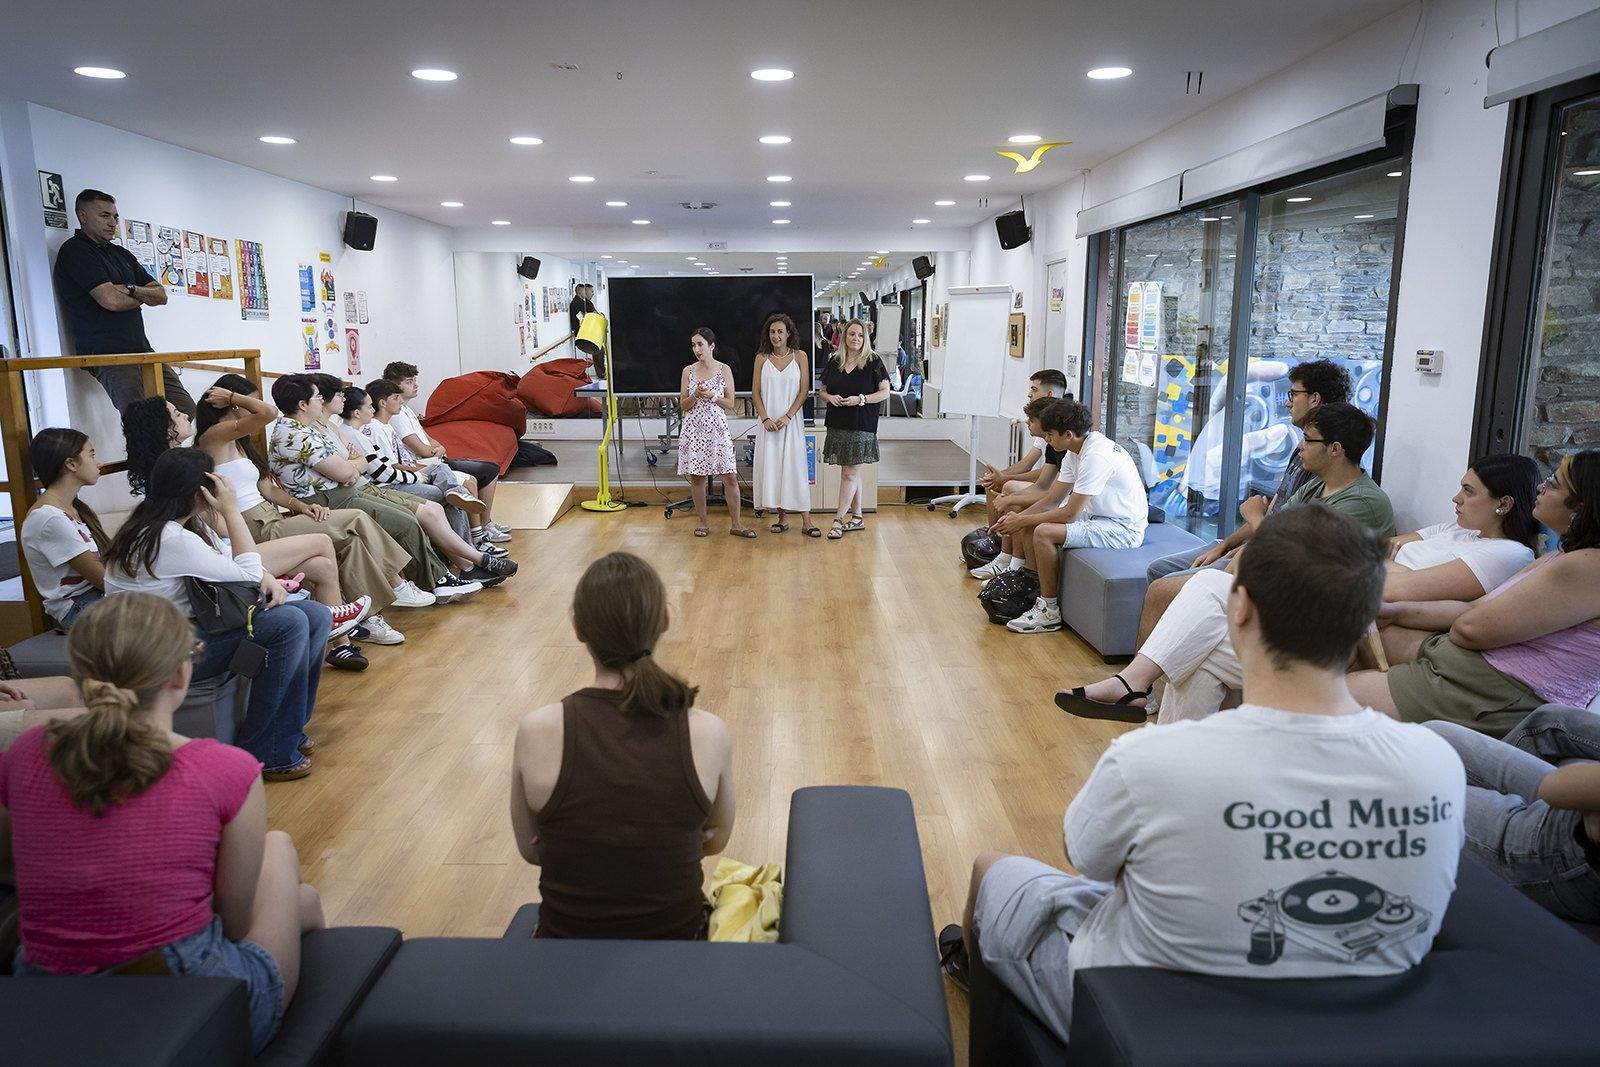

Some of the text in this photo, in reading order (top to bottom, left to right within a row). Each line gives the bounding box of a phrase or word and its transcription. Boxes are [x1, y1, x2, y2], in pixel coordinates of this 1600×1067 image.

[1223, 795, 1452, 830] Good Music
[1264, 829, 1427, 860] Records
